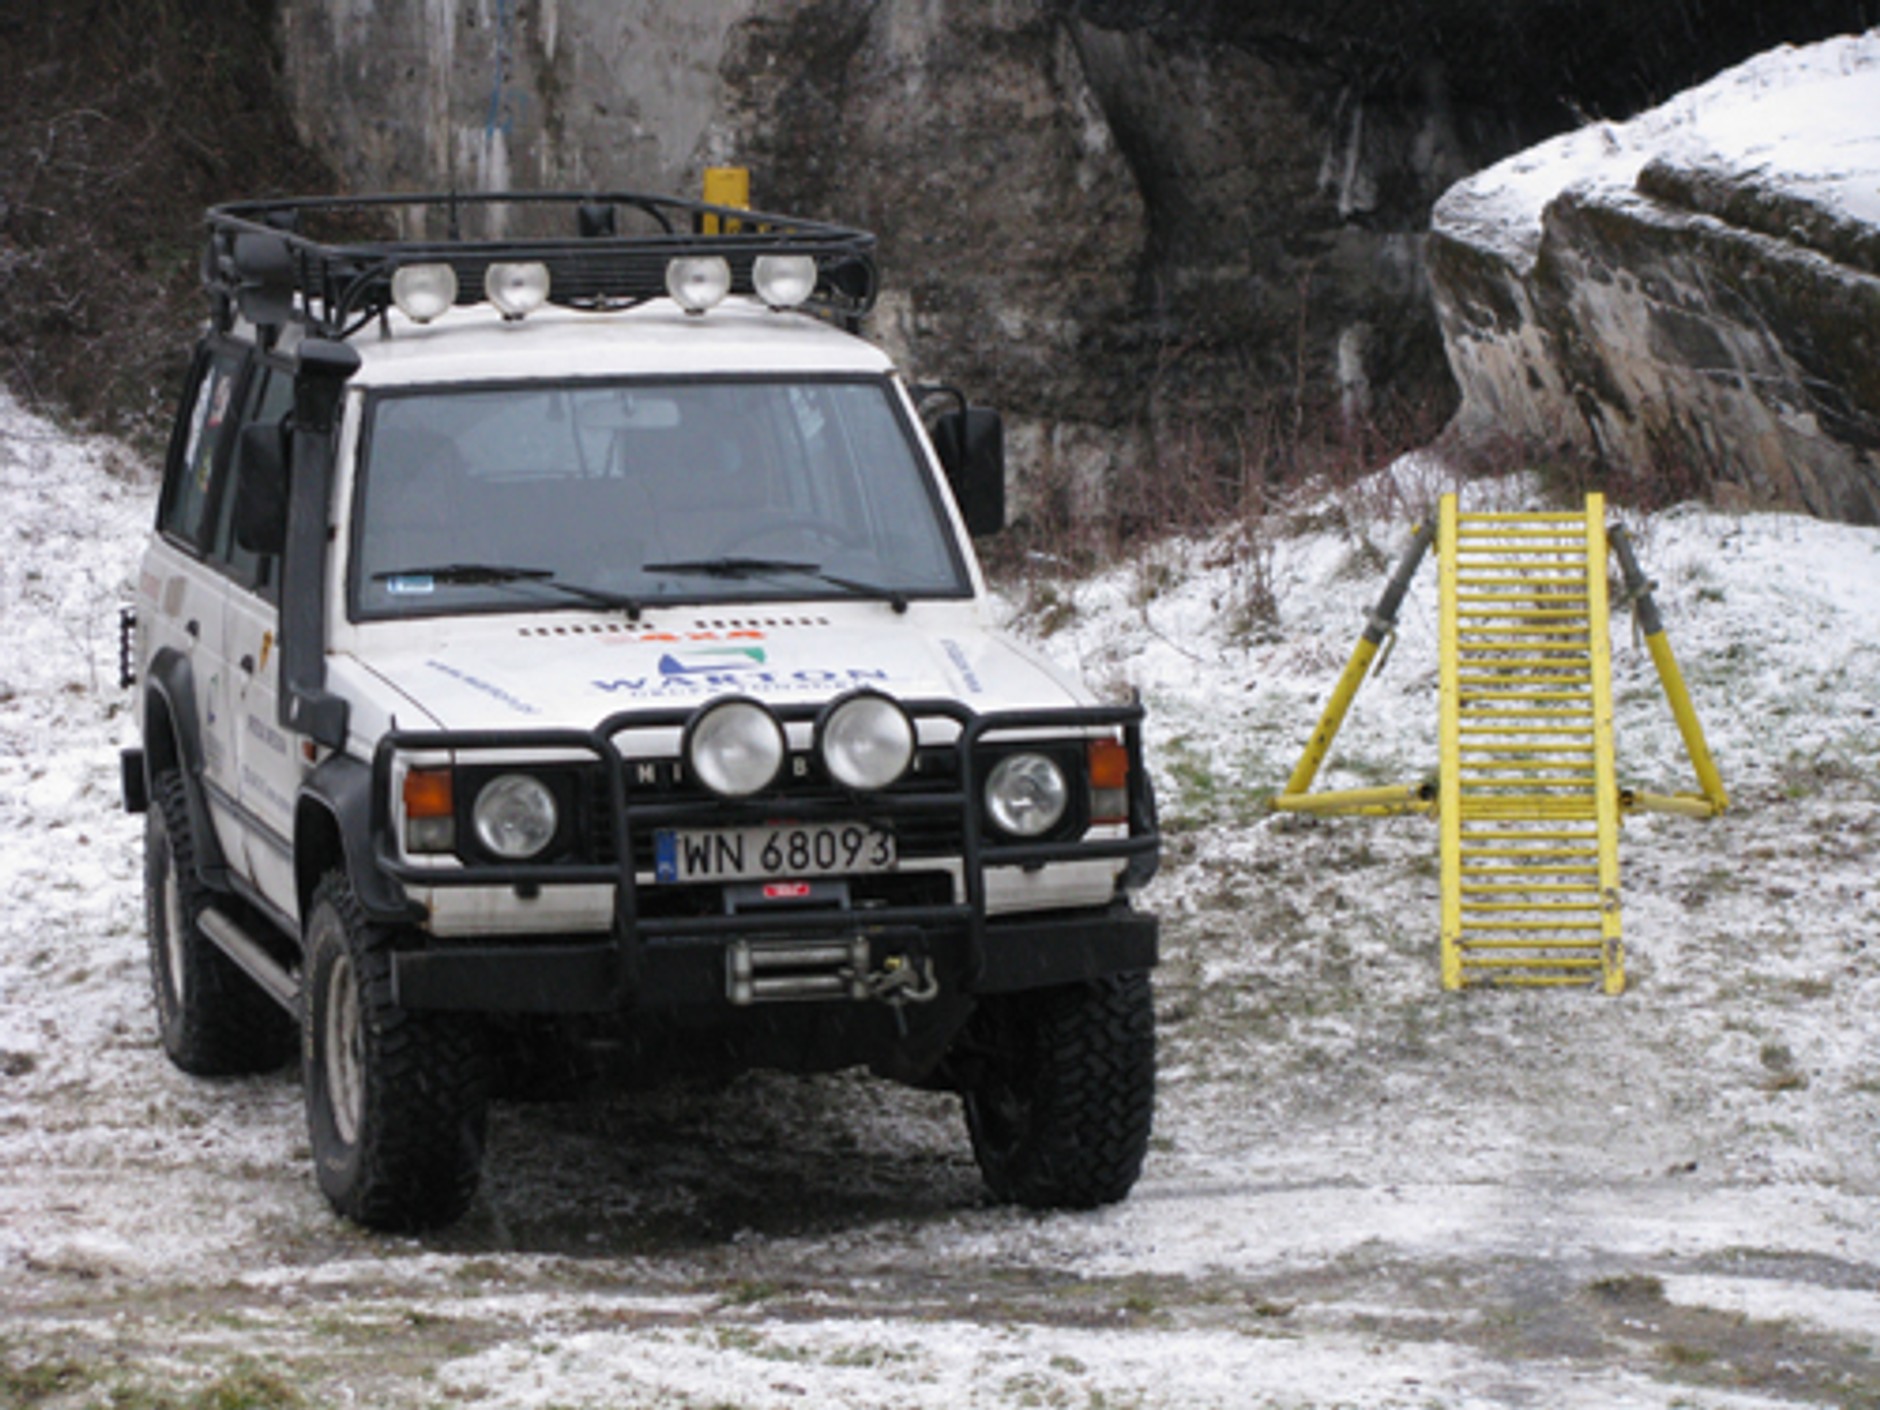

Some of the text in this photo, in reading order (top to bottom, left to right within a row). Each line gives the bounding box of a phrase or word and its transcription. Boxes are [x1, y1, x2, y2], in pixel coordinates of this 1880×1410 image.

[591, 669, 887, 692] WARTON
[683, 832, 744, 876] WN
[760, 826, 890, 872] 68093
